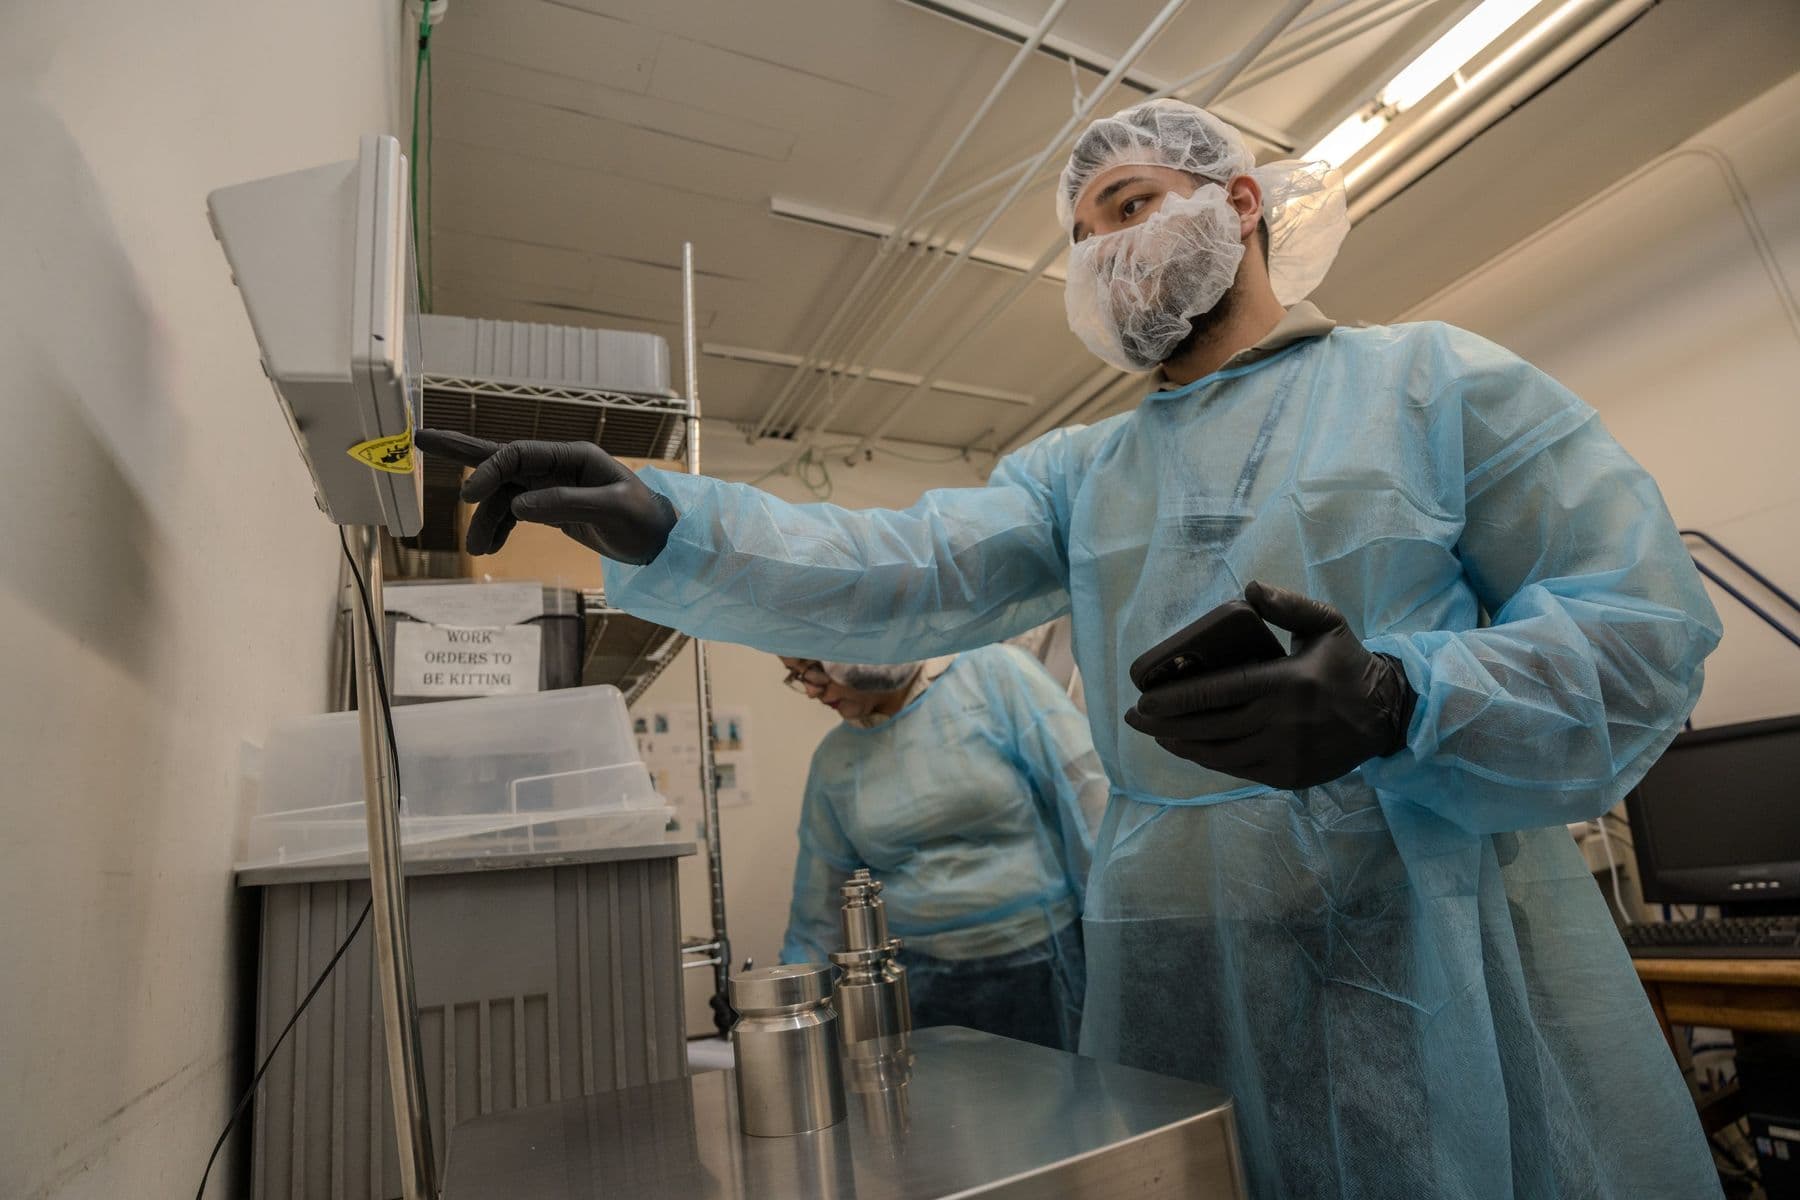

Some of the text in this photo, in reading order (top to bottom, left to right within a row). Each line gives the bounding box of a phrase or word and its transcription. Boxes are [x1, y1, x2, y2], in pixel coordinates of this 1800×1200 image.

[447, 630, 493, 643] WORK
[424, 651, 512, 664] ORDERS TO
[423, 672, 512, 686] BE KITTING
